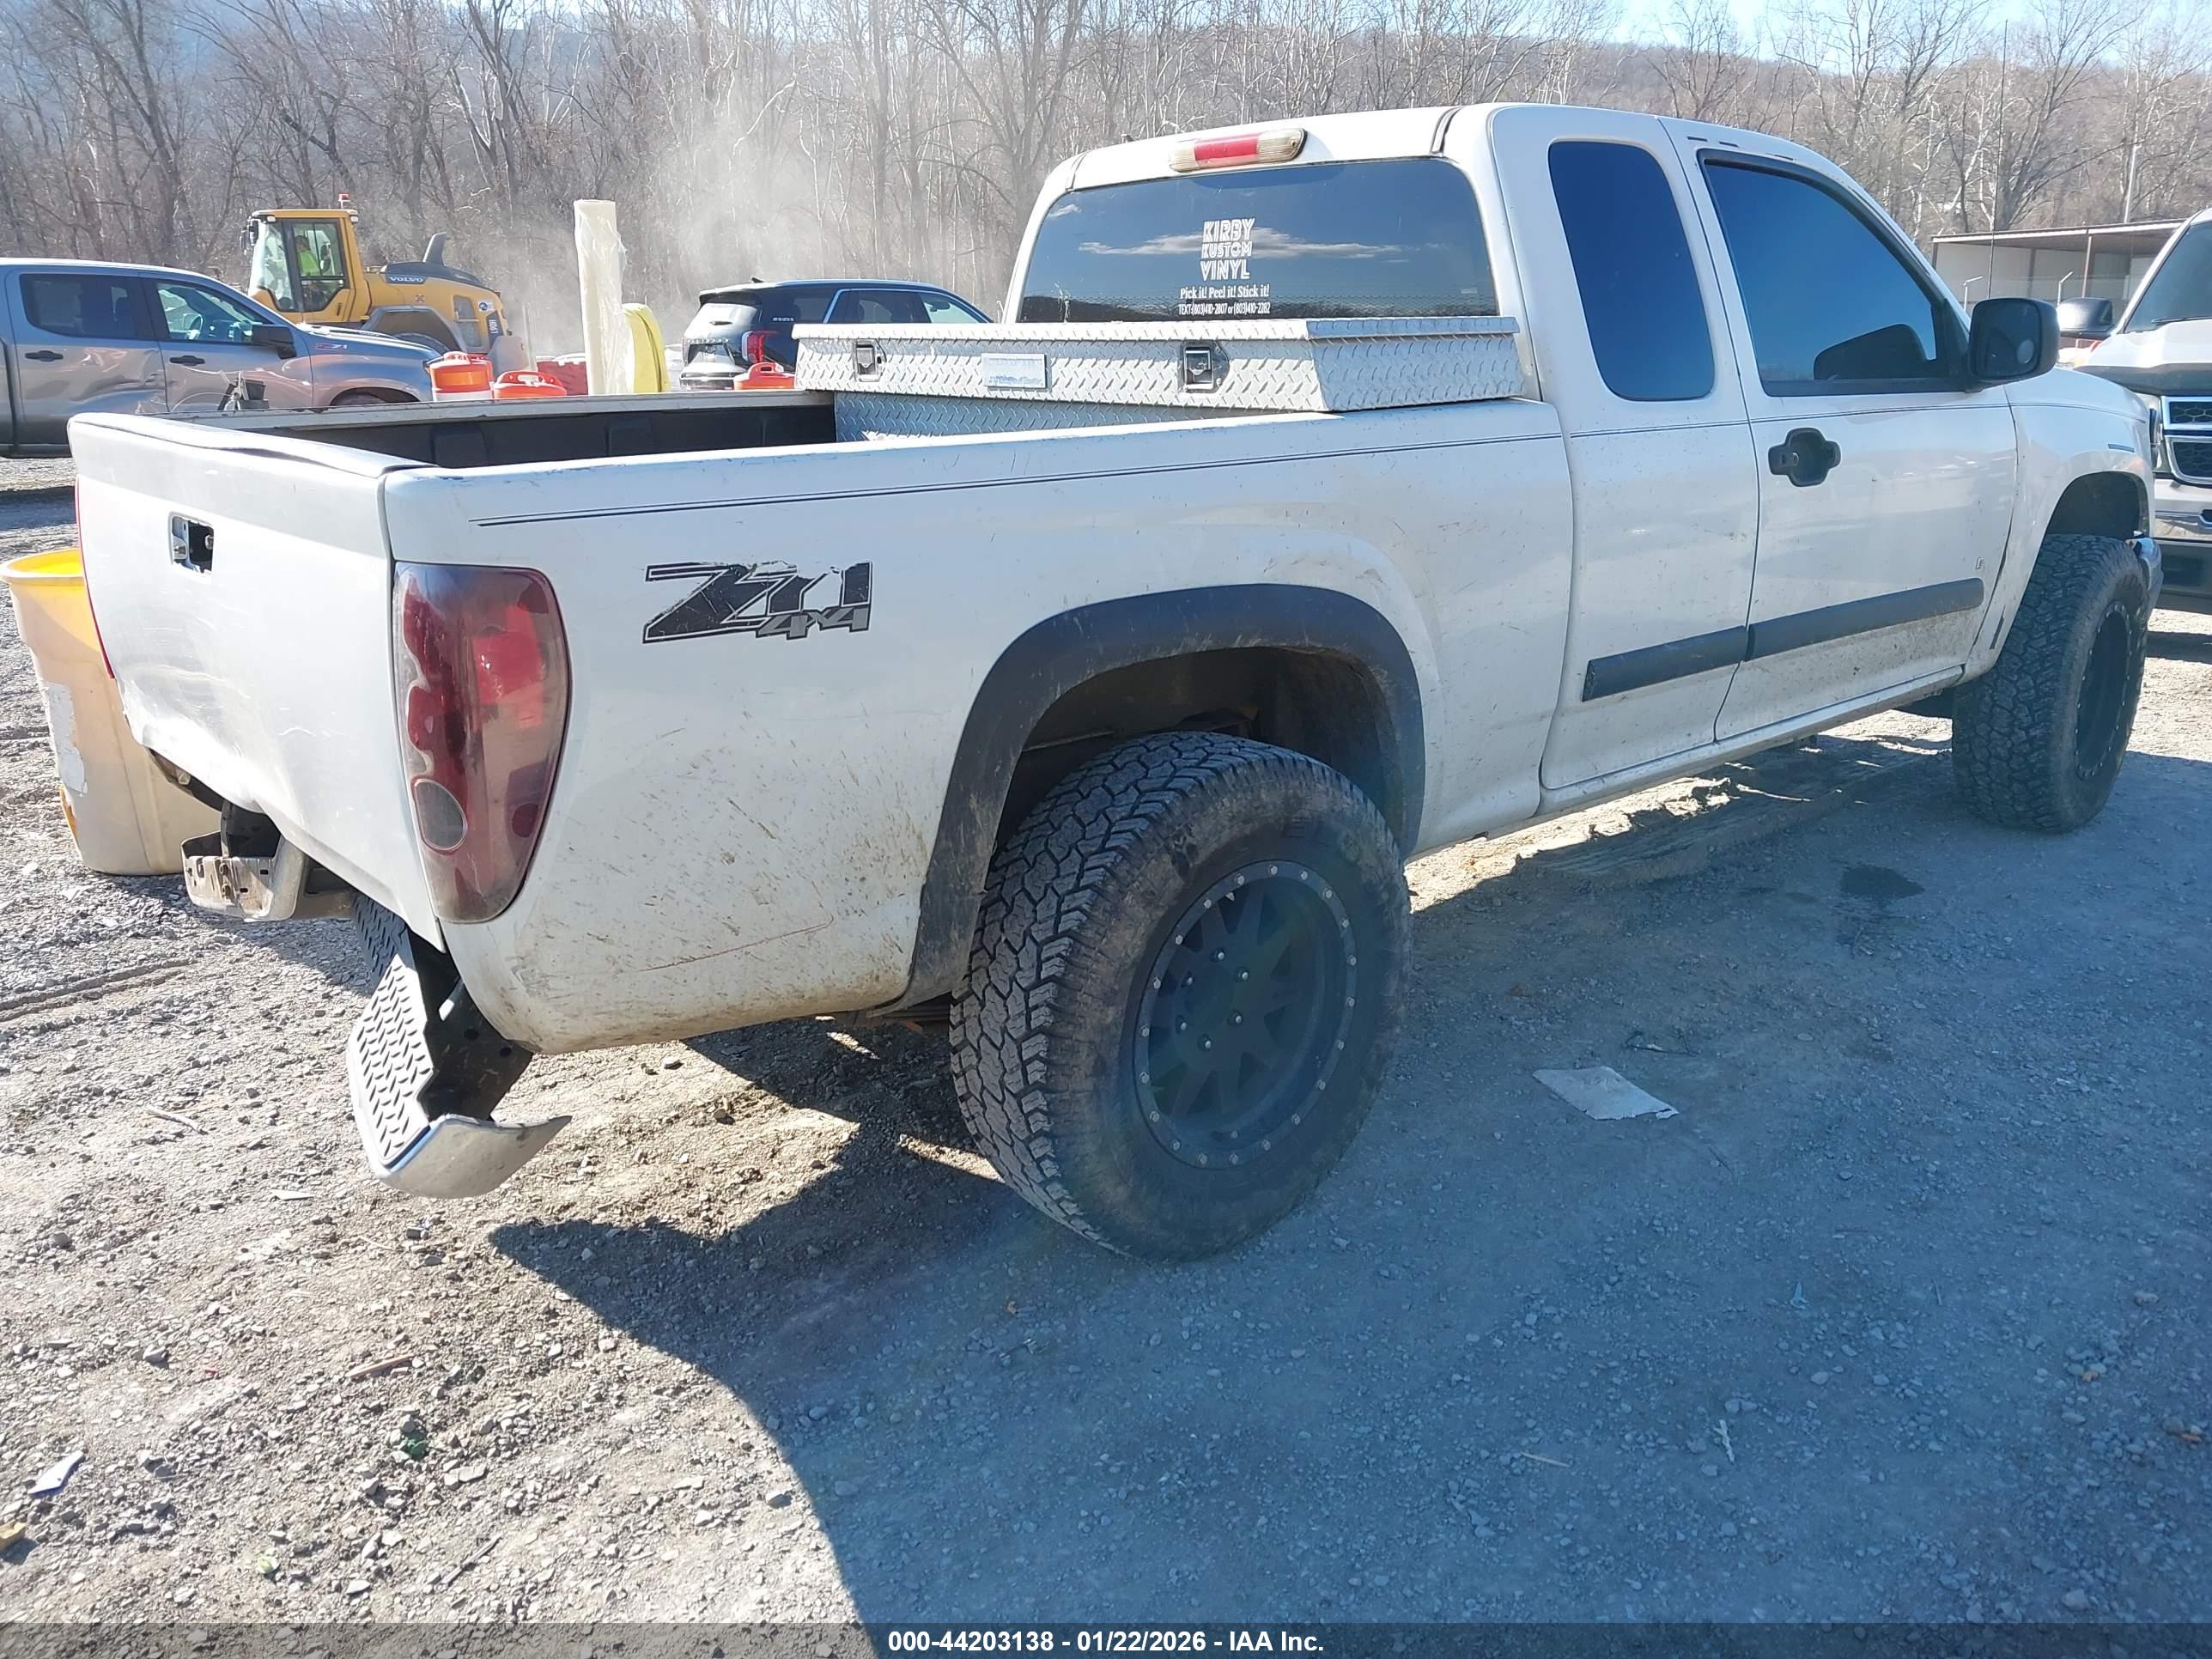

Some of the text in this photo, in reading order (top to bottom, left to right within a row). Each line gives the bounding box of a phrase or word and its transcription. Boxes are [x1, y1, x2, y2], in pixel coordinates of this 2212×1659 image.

[1203, 218, 1255, 242] KIRBY
[1201, 240, 1252, 259] KUSTOM
[1200, 258, 1250, 281] VINYL
[1180, 283, 1270, 299] Pick it! Peel it! Stick it!
